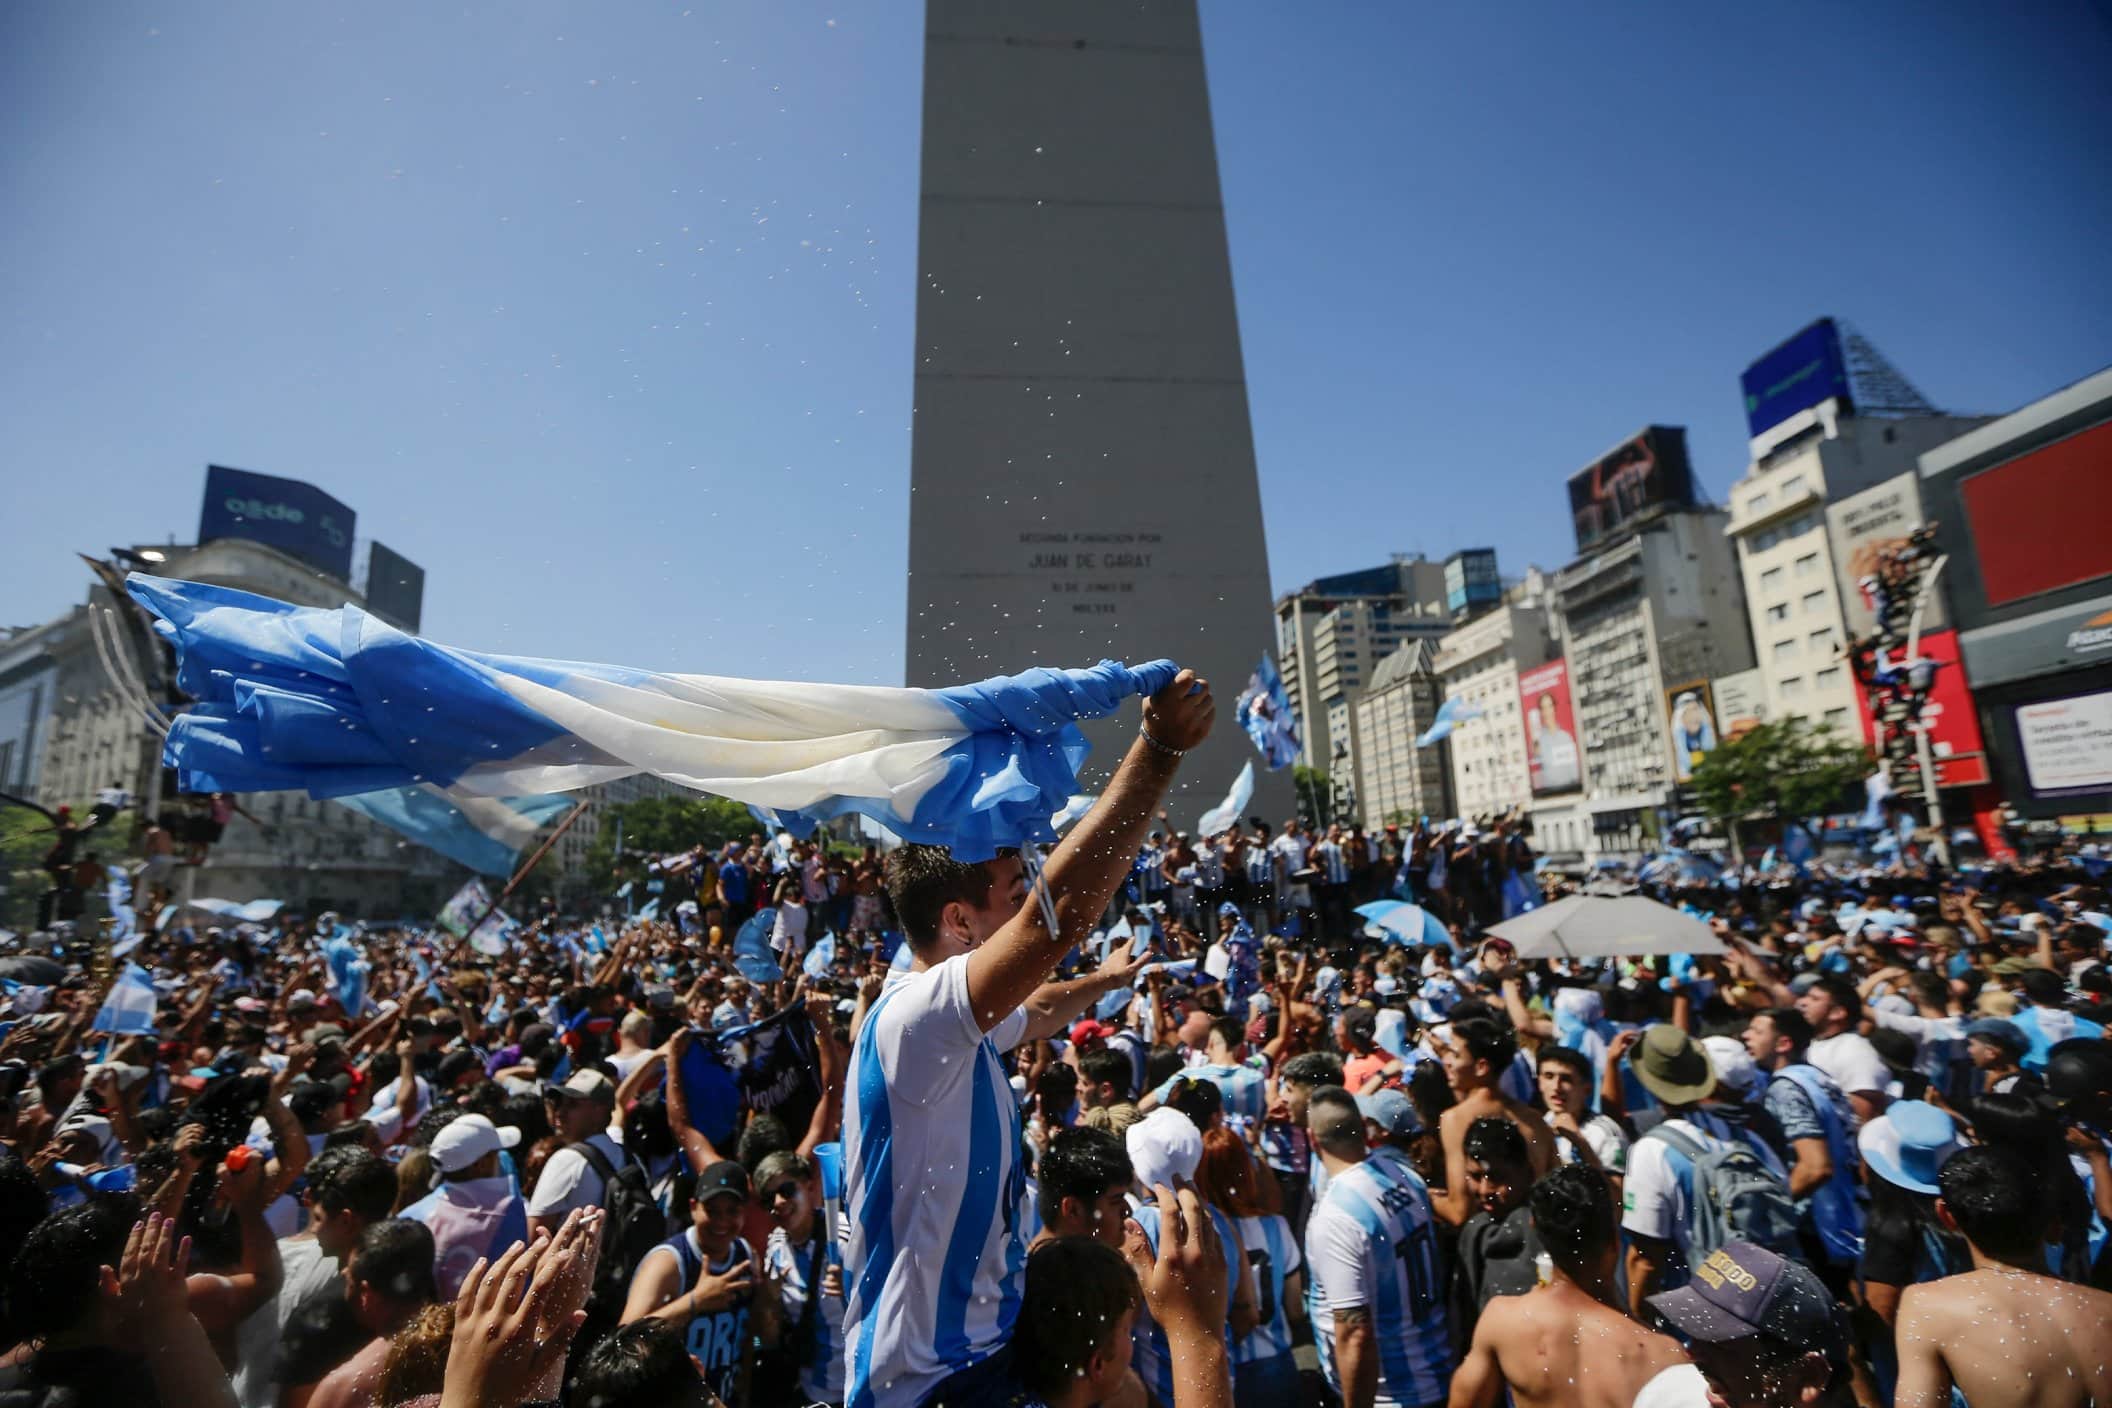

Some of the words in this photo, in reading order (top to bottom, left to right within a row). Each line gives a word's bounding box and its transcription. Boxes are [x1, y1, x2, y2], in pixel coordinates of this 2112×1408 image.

[1028, 552, 1068, 568] JUAN
[1075, 553, 1097, 568] DE
[1103, 552, 1152, 568] GARAY
